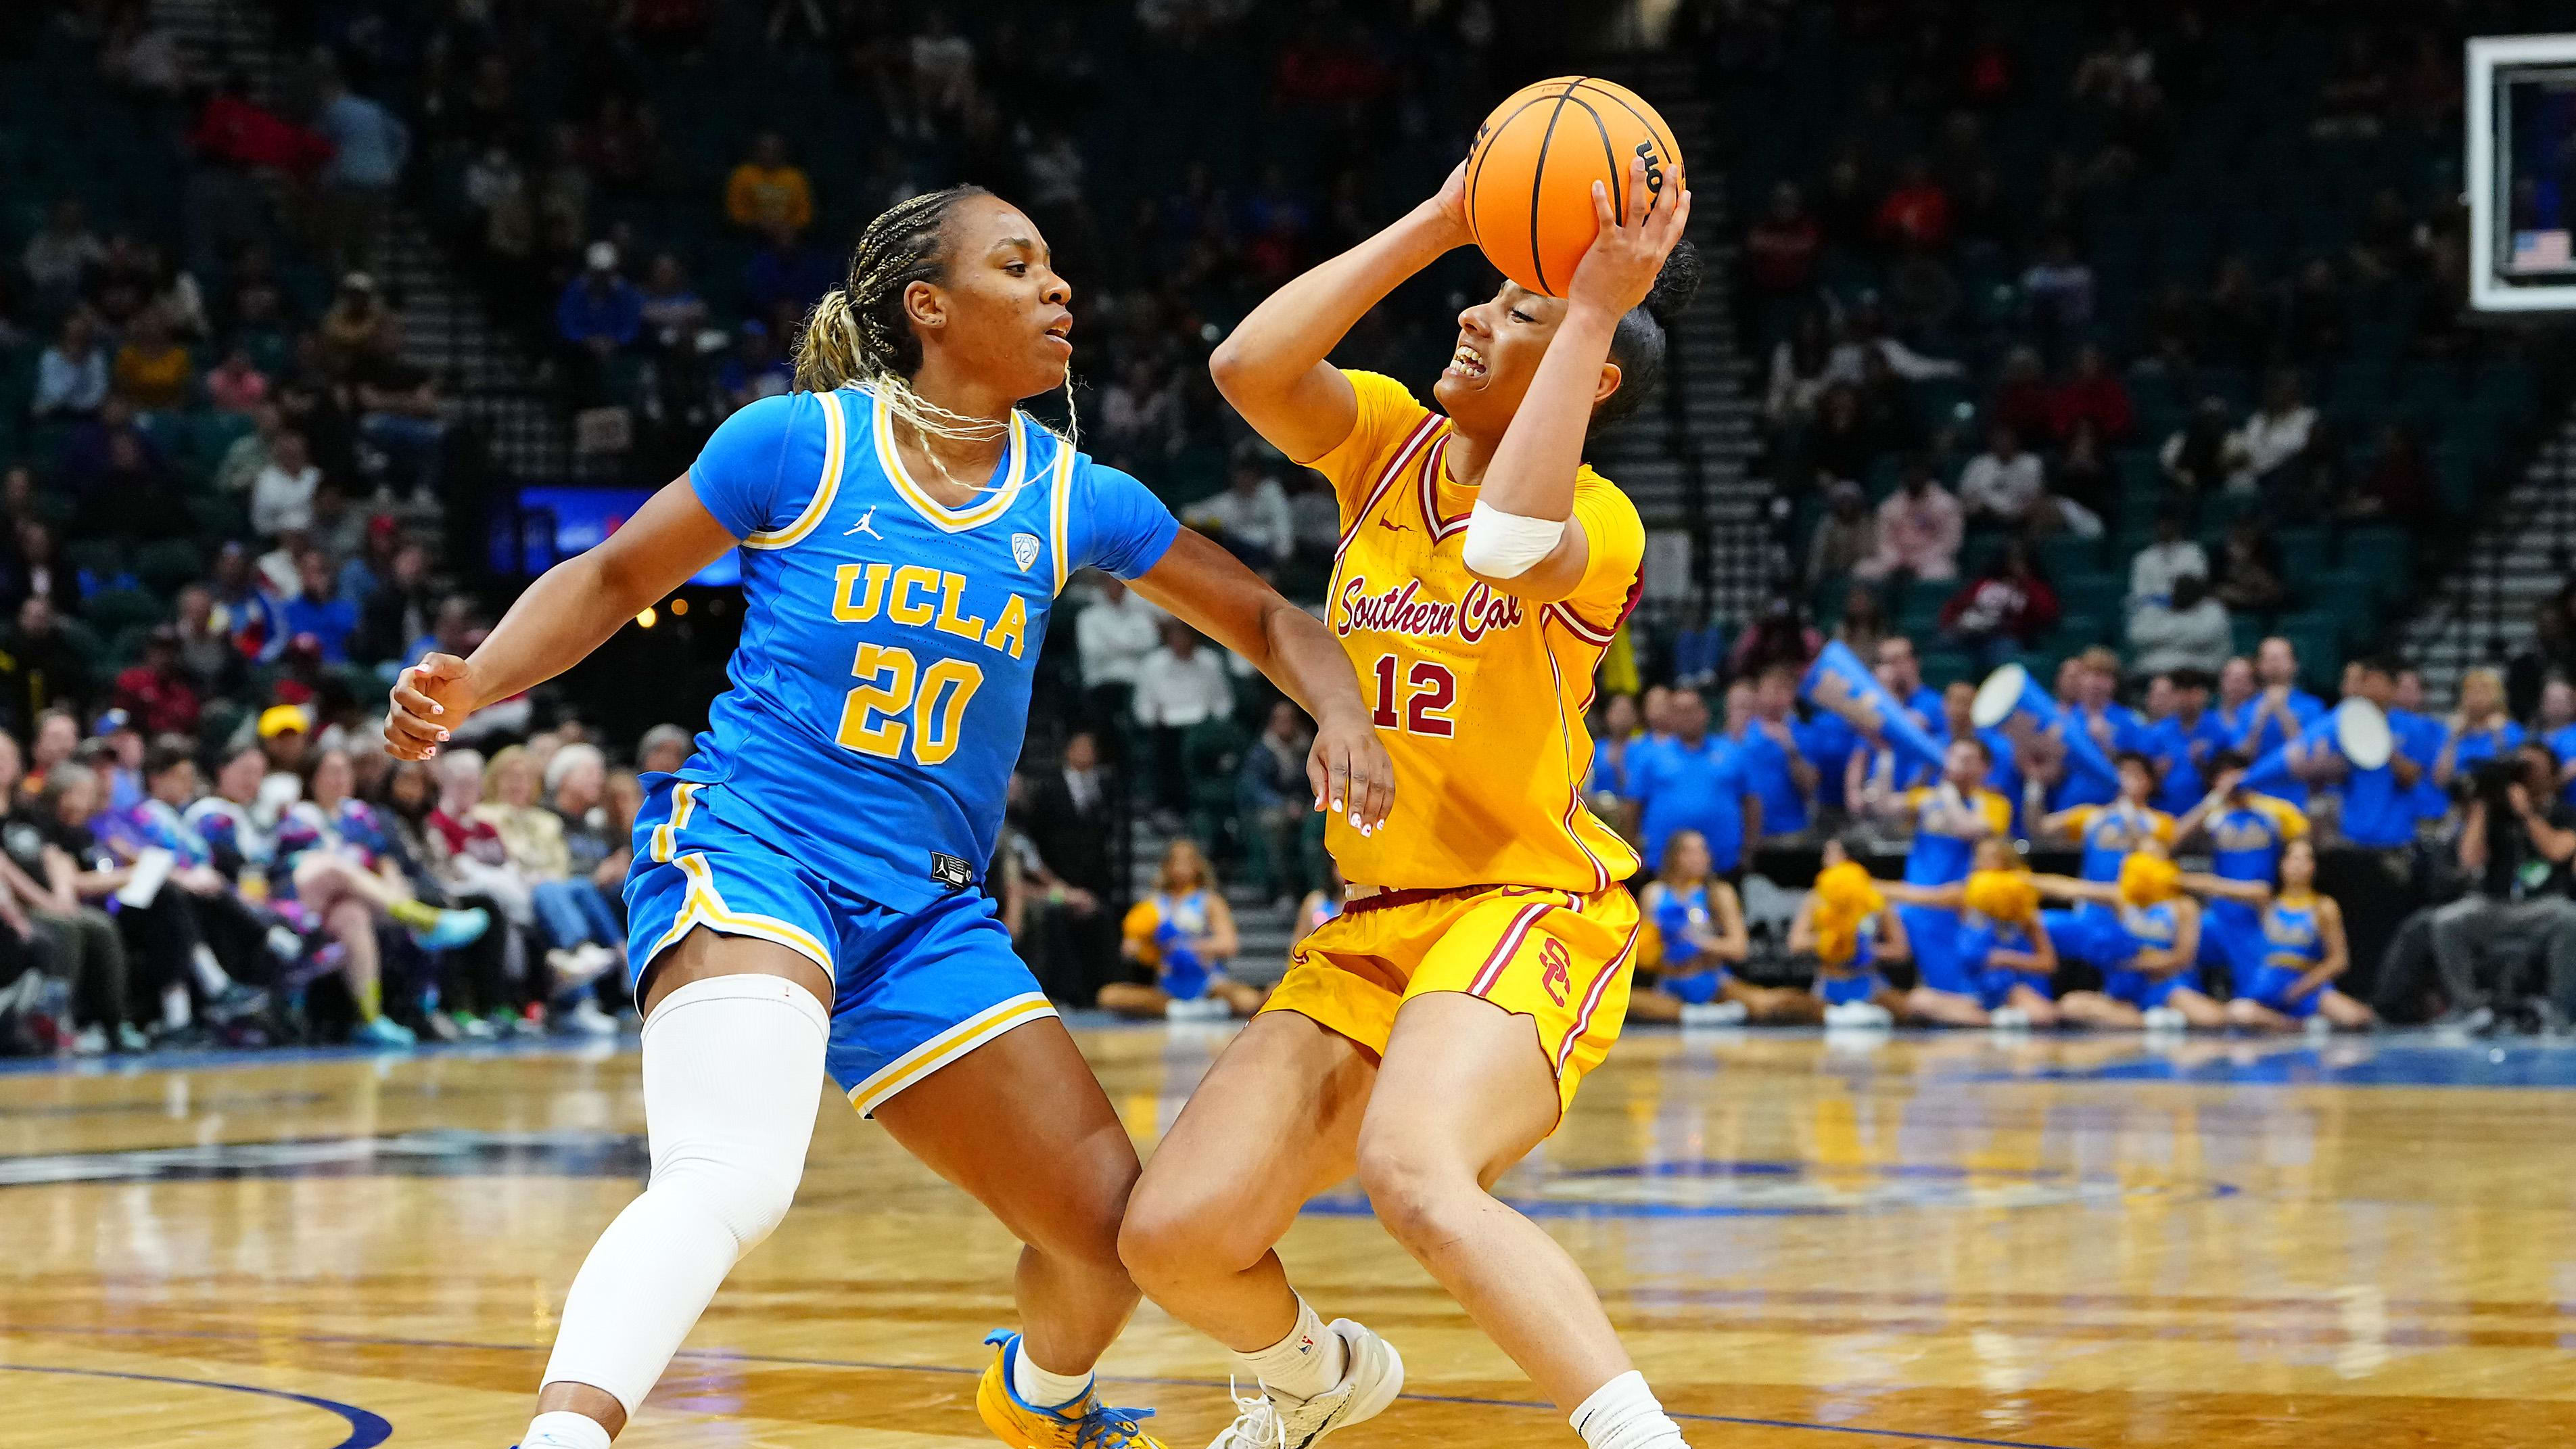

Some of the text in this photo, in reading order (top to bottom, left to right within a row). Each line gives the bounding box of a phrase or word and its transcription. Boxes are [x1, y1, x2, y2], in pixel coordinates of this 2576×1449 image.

[1018, 549, 1031, 564] 12
[832, 564, 1027, 660] UCLA
[1336, 576, 1522, 645] Southern Cal
[835, 642, 984, 765] 20
[1372, 653, 1457, 739] 12
